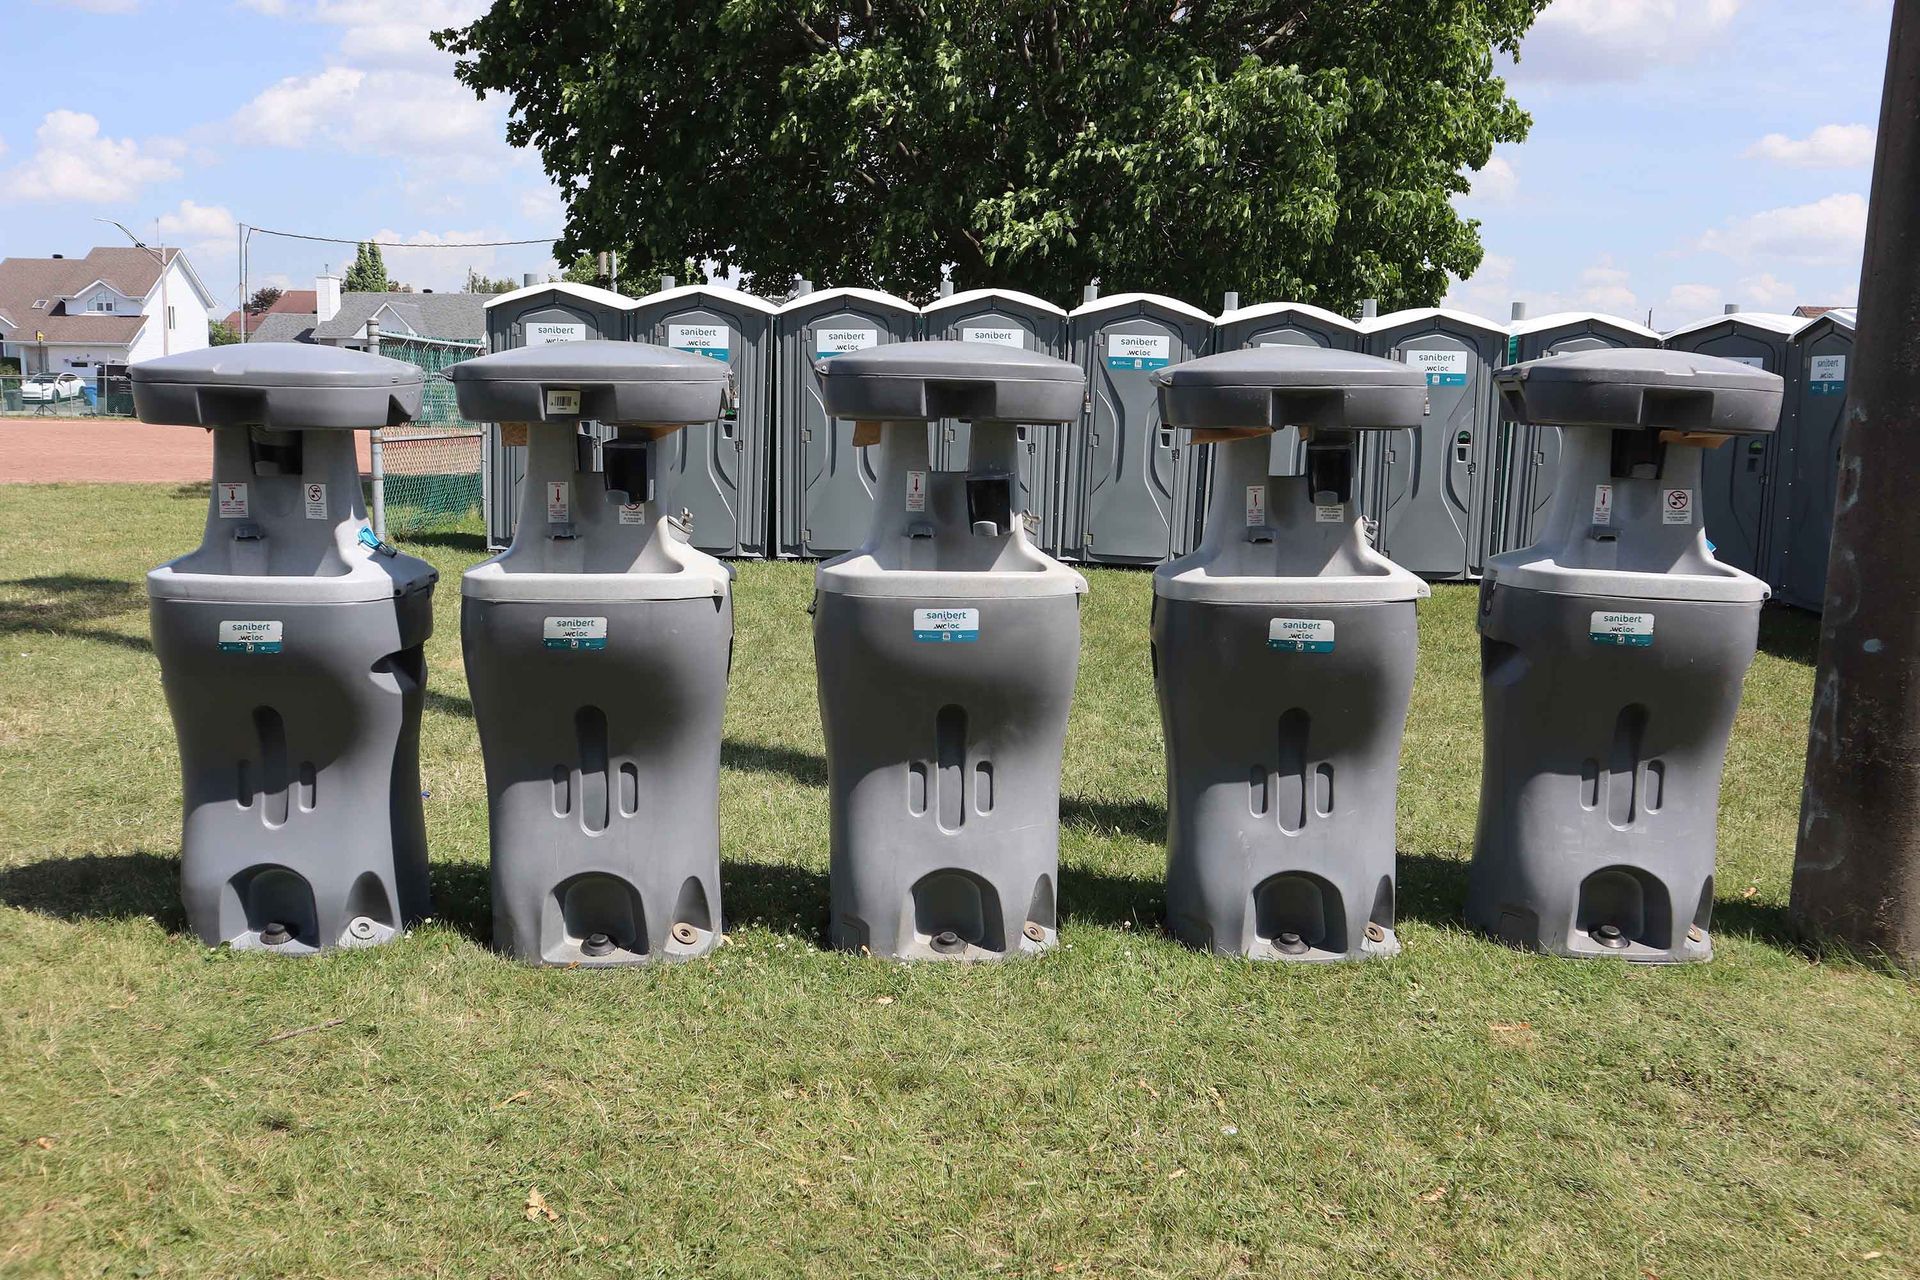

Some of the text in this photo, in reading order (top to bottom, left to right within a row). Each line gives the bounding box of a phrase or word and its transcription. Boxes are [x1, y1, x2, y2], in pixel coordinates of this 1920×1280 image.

[538, 325, 574, 335] sanibert
[680, 328, 717, 337] sanibert
[975, 330, 1012, 340] sanibert
[828, 331, 865, 341] sanibert
[1120, 337, 1157, 347] sanibert
[1418, 353, 1455, 362] sanibert
[926, 610, 967, 620] sanibert
[1603, 614, 1642, 623] sanibert
[232, 622, 271, 632] sanibert
[556, 618, 595, 627] sanibert
[1282, 621, 1321, 630] sanibert
